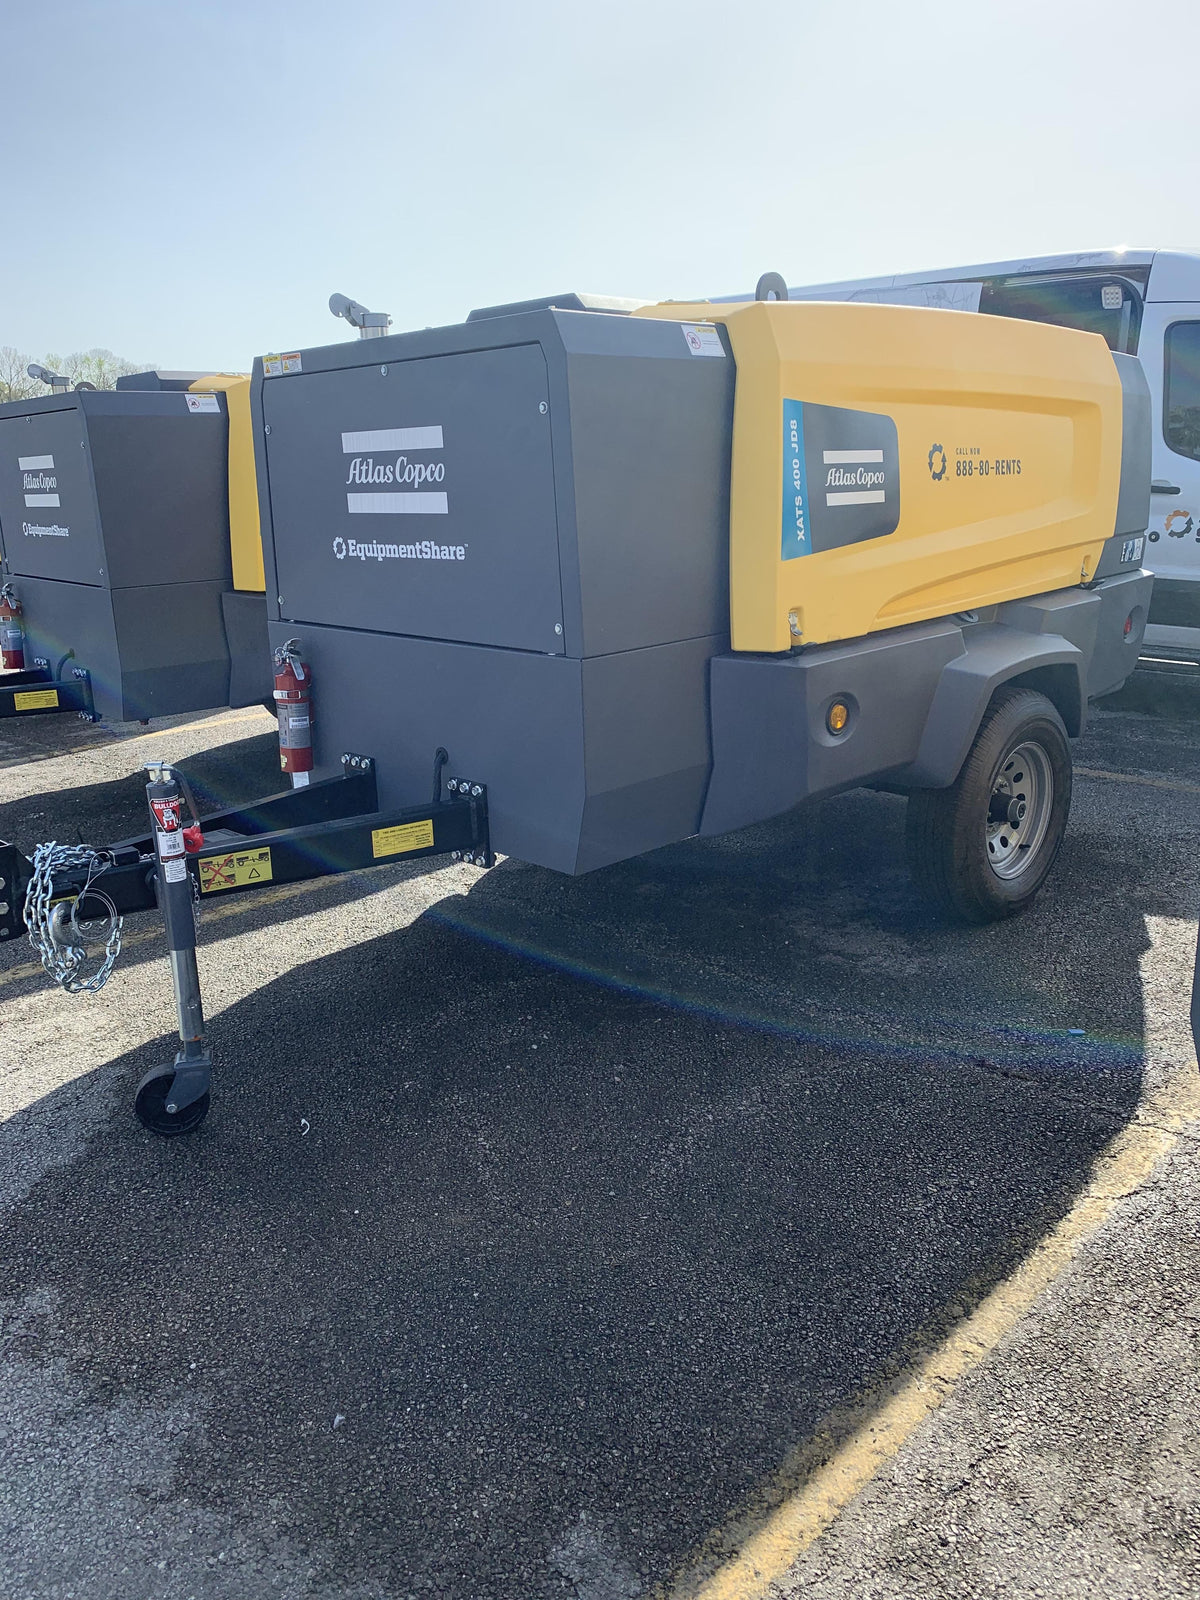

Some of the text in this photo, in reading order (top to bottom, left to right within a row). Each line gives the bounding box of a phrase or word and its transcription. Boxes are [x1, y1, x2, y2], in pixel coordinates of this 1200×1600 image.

[955, 447, 981, 455] CALL NOW
[345, 456, 445, 489] Atlas Copco
[825, 467, 885, 488] Atlas Copco
[956, 459, 1021, 476] 888-80-RENTS
[23, 472, 57, 492] Atlas Copco
[789, 419, 806, 541] XATS 400 JD8
